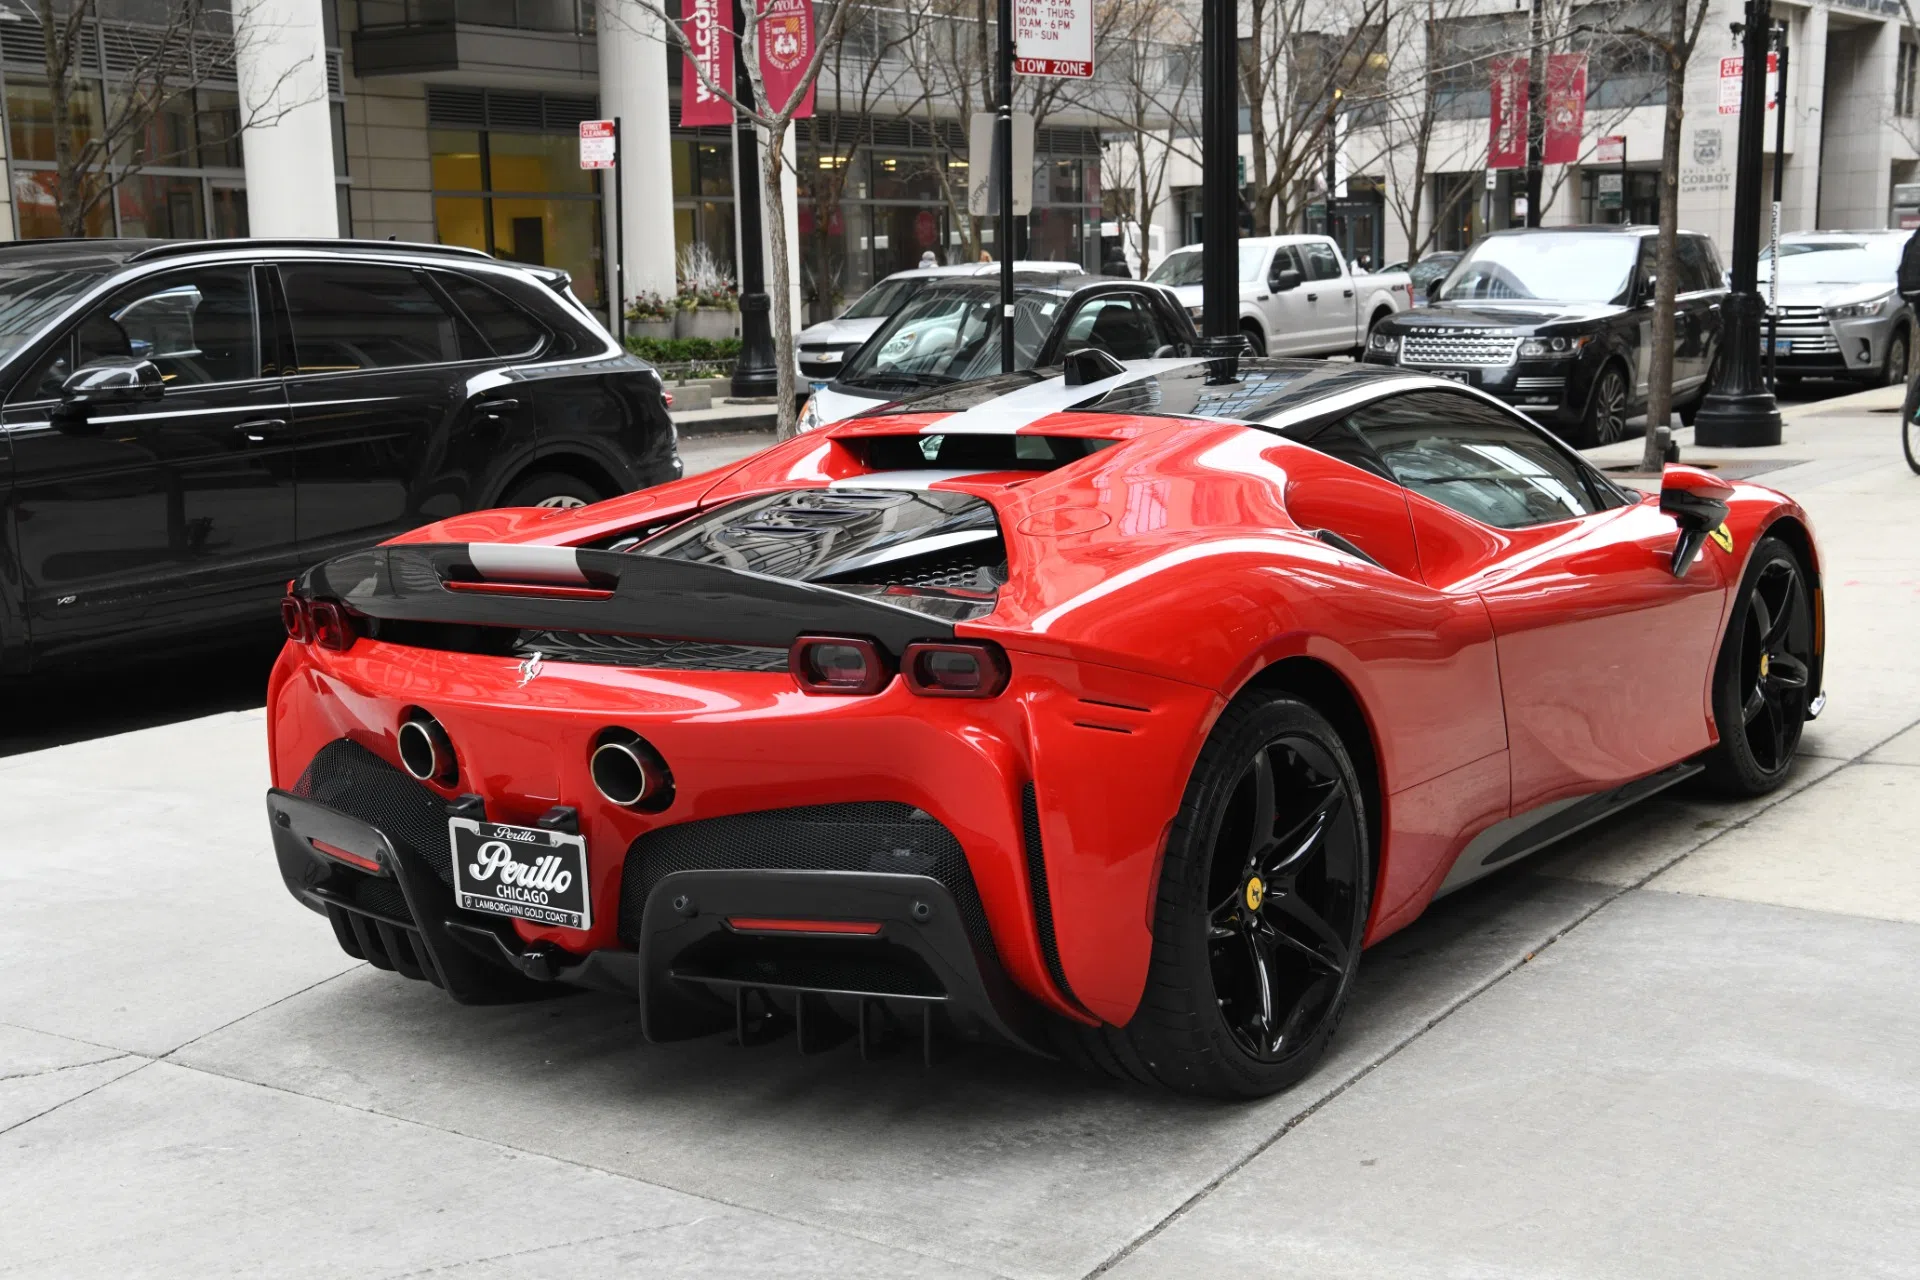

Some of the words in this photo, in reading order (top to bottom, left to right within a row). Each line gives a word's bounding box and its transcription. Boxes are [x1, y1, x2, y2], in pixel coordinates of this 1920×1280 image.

[1018, 6, 1037, 16] MON
[1047, 7, 1075, 19] THURS
[1019, 17, 1027, 27] 10
[1029, 18, 1041, 28] AM
[1050, 20, 1056, 29] 6
[1058, 20, 1070, 30] PM
[711, 20, 720, 61] TOWER
[1018, 29, 1033, 39] FRI
[1041, 30, 1059, 40] SUN
[1019, 59, 1047, 73] TOW
[1052, 61, 1087, 75] ZONE
[1682, 173, 1732, 184] CORBOY
[1770, 204, 1778, 271] CONSIGNMENT
[494, 826, 537, 842] Perillo
[469, 841, 572, 893] Perillo
[496, 884, 549, 905] CHICAGO
[475, 899, 524, 915] LAMBORGHINI
[524, 908, 544, 919] GOLD
[545, 911, 568, 923] COAST
